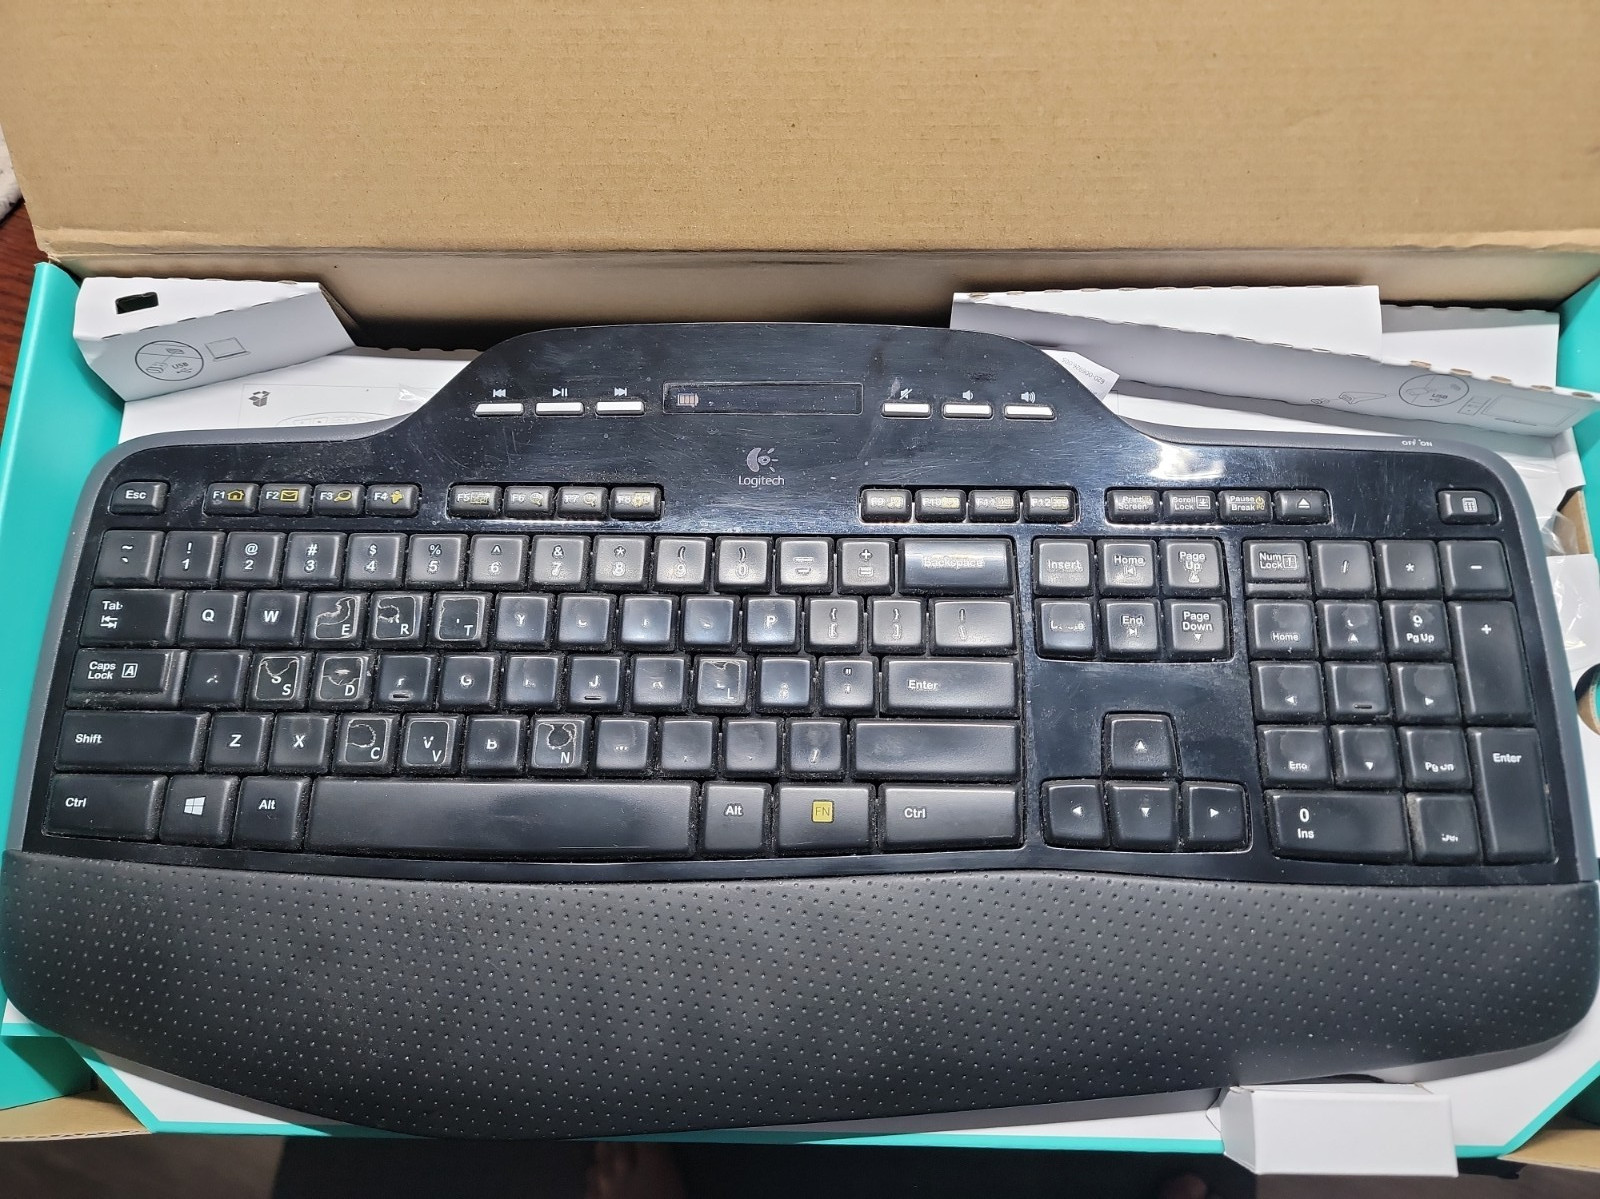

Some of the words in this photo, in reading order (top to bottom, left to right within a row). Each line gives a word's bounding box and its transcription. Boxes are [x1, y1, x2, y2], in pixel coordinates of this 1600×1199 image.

[738, 475, 785, 487] Logitech
[125, 490, 146, 499] Esc
[213, 490, 225, 499] F1
[266, 491, 279, 500] F2
[320, 492, 333, 500] F3
[374, 493, 387, 501] F4
[456, 494, 469, 502] F5
[511, 494, 524, 502] F6
[186, 543, 192, 554] !
[245, 543, 258, 555] @
[307, 544, 318, 556] #
[369, 544, 377, 556] $
[429, 544, 442, 556] %
[553, 546, 564, 558] &
[679, 546, 686, 560] (
[739, 547, 746, 560] )
[859, 549, 872, 561] +
[1114, 555, 1144, 565] Home
[1179, 551, 1205, 562] Page
[1259, 553, 1282, 562] Num
[183, 560, 190, 570] 1
[244, 560, 254, 570] 2
[305, 560, 315, 571] 3
[365, 560, 376, 571] 4
[428, 560, 438, 572] 5
[490, 562, 500, 573] 6
[552, 562, 561, 575] 7
[922, 556, 985, 570] Backspace
[1048, 559, 1082, 570] Insert
[1185, 560, 1201, 571] Up
[1260, 560, 1283, 569] Lock
[614, 562, 625, 576] 8
[676, 564, 686, 577] 9
[737, 563, 748, 577] 0
[102, 601, 123, 610] Tab
[202, 610, 215, 623] Q
[264, 610, 280, 622] W
[516, 614, 525, 626] Y
[1122, 616, 1143, 626] End
[1184, 612, 1210, 623] Page
[1413, 615, 1423, 628] 9
[765, 615, 777, 629] P
[1182, 622, 1212, 632] Down
[341, 624, 350, 635] E
[400, 624, 410, 635] R
[464, 625, 473, 636] T
[1481, 624, 1492, 634] +
[1272, 632, 1299, 641] Home
[1407, 633, 1419, 643] Pg
[1420, 633, 1435, 643] Up
[89, 661, 116, 672] Caps
[87, 670, 113, 680] Lock
[460, 675, 472, 686] G
[589, 675, 600, 687] J
[908, 680, 939, 690] Enter
[282, 684, 292, 696] S
[344, 684, 355, 696] D
[727, 688, 734, 699] L
[75, 734, 102, 744] Shift
[229, 735, 241, 747] Z
[294, 735, 305, 748] X
[423, 736, 434, 749] V
[371, 747, 380, 760] C
[432, 750, 441, 762] V
[561, 752, 570, 763] N
[1493, 753, 1522, 763] Enter
[1425, 761, 1439, 773] Pg
[65, 797, 87, 808] Ctrl
[258, 799, 275, 810] Alt
[725, 804, 742, 816] Alt
[815, 806, 830, 817] FN
[904, 808, 926, 818] Ctrl
[1300, 809, 1310, 822] 0
[1297, 828, 1315, 839] Ins
